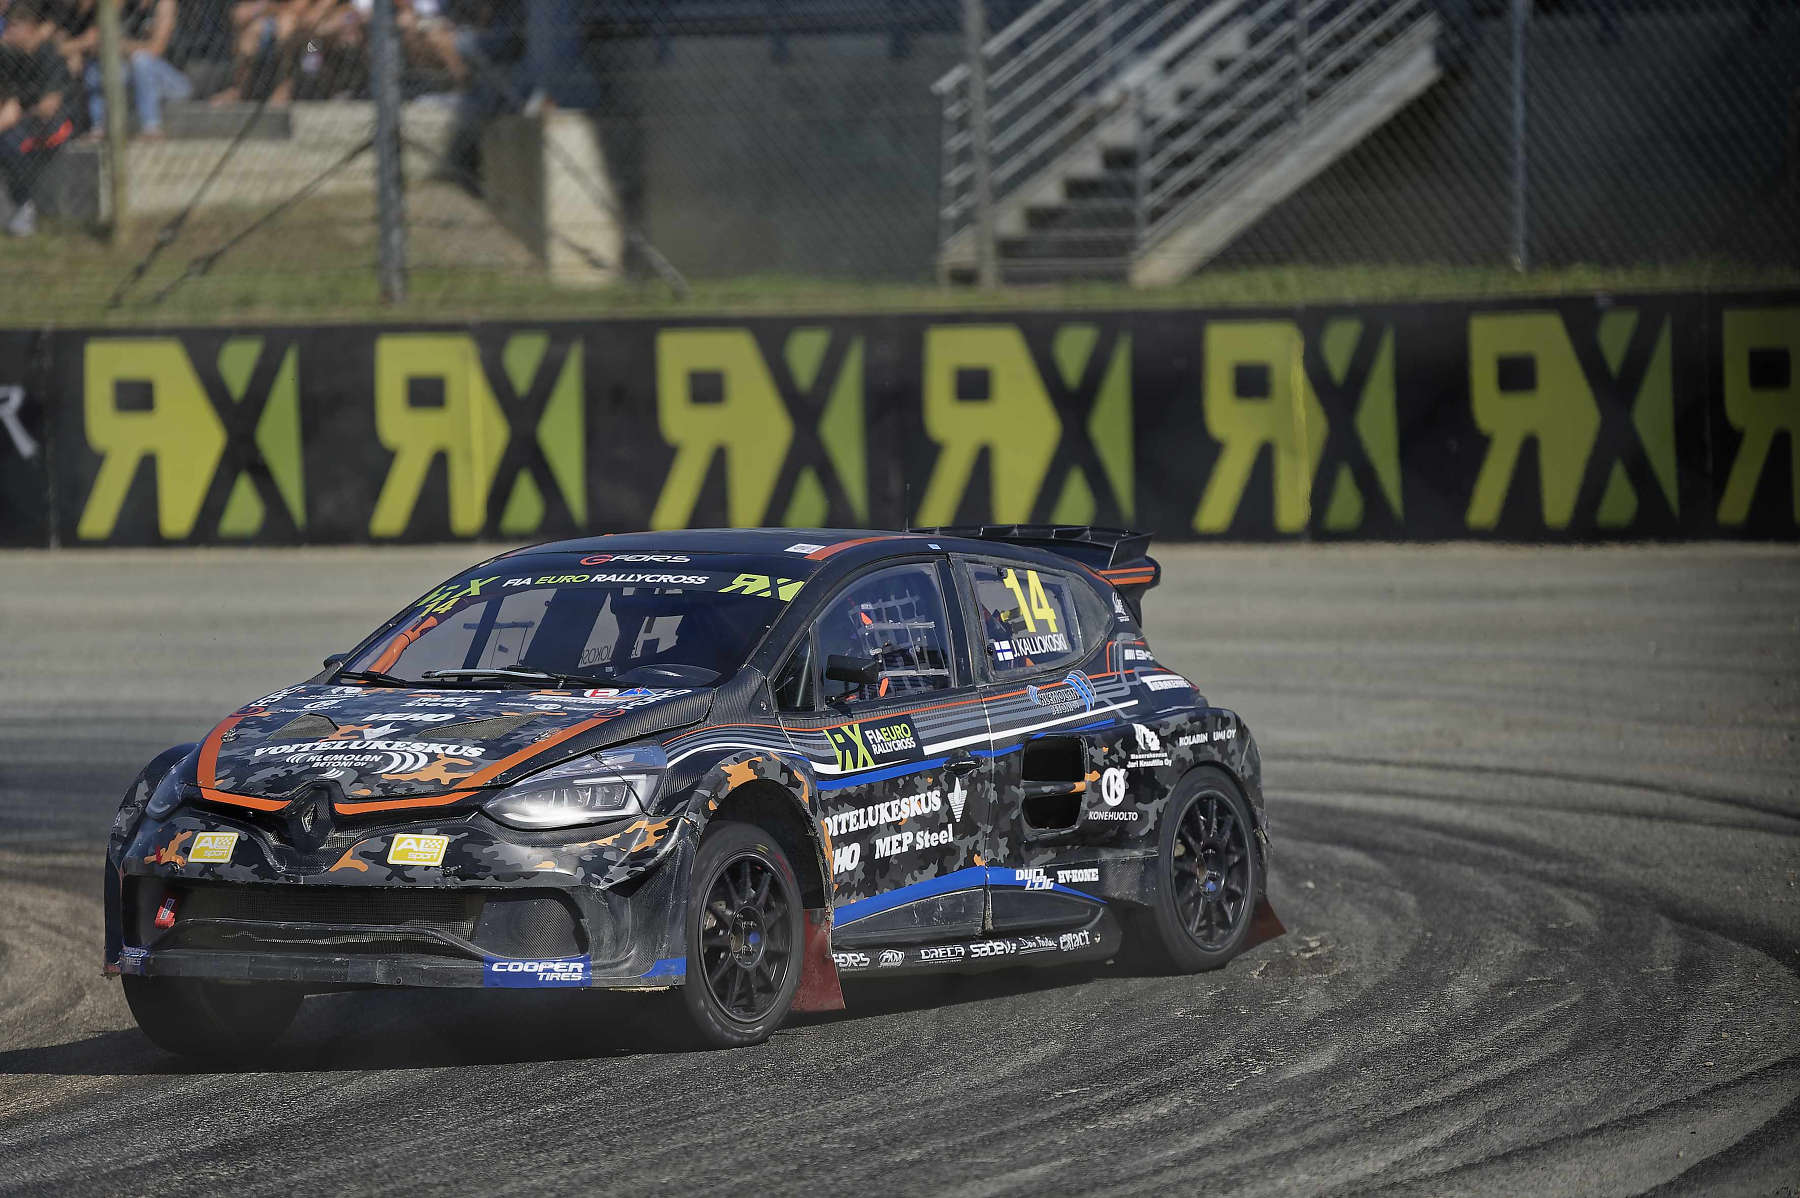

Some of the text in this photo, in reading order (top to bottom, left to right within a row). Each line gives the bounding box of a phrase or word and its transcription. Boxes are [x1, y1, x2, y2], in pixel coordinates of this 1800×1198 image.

[502, 573, 709, 587] FIA EURO RALLYCROSS
[1003, 568, 1058, 633] 14
[254, 740, 486, 758] VOITELUKESKUS
[872, 737, 916, 755] RALLYCROSS
[1088, 811, 1138, 821] KONEHUOLTO
[874, 823, 954, 860] MEP Steel
[491, 961, 585, 973] COOPER
[537, 972, 583, 981] TIRES
